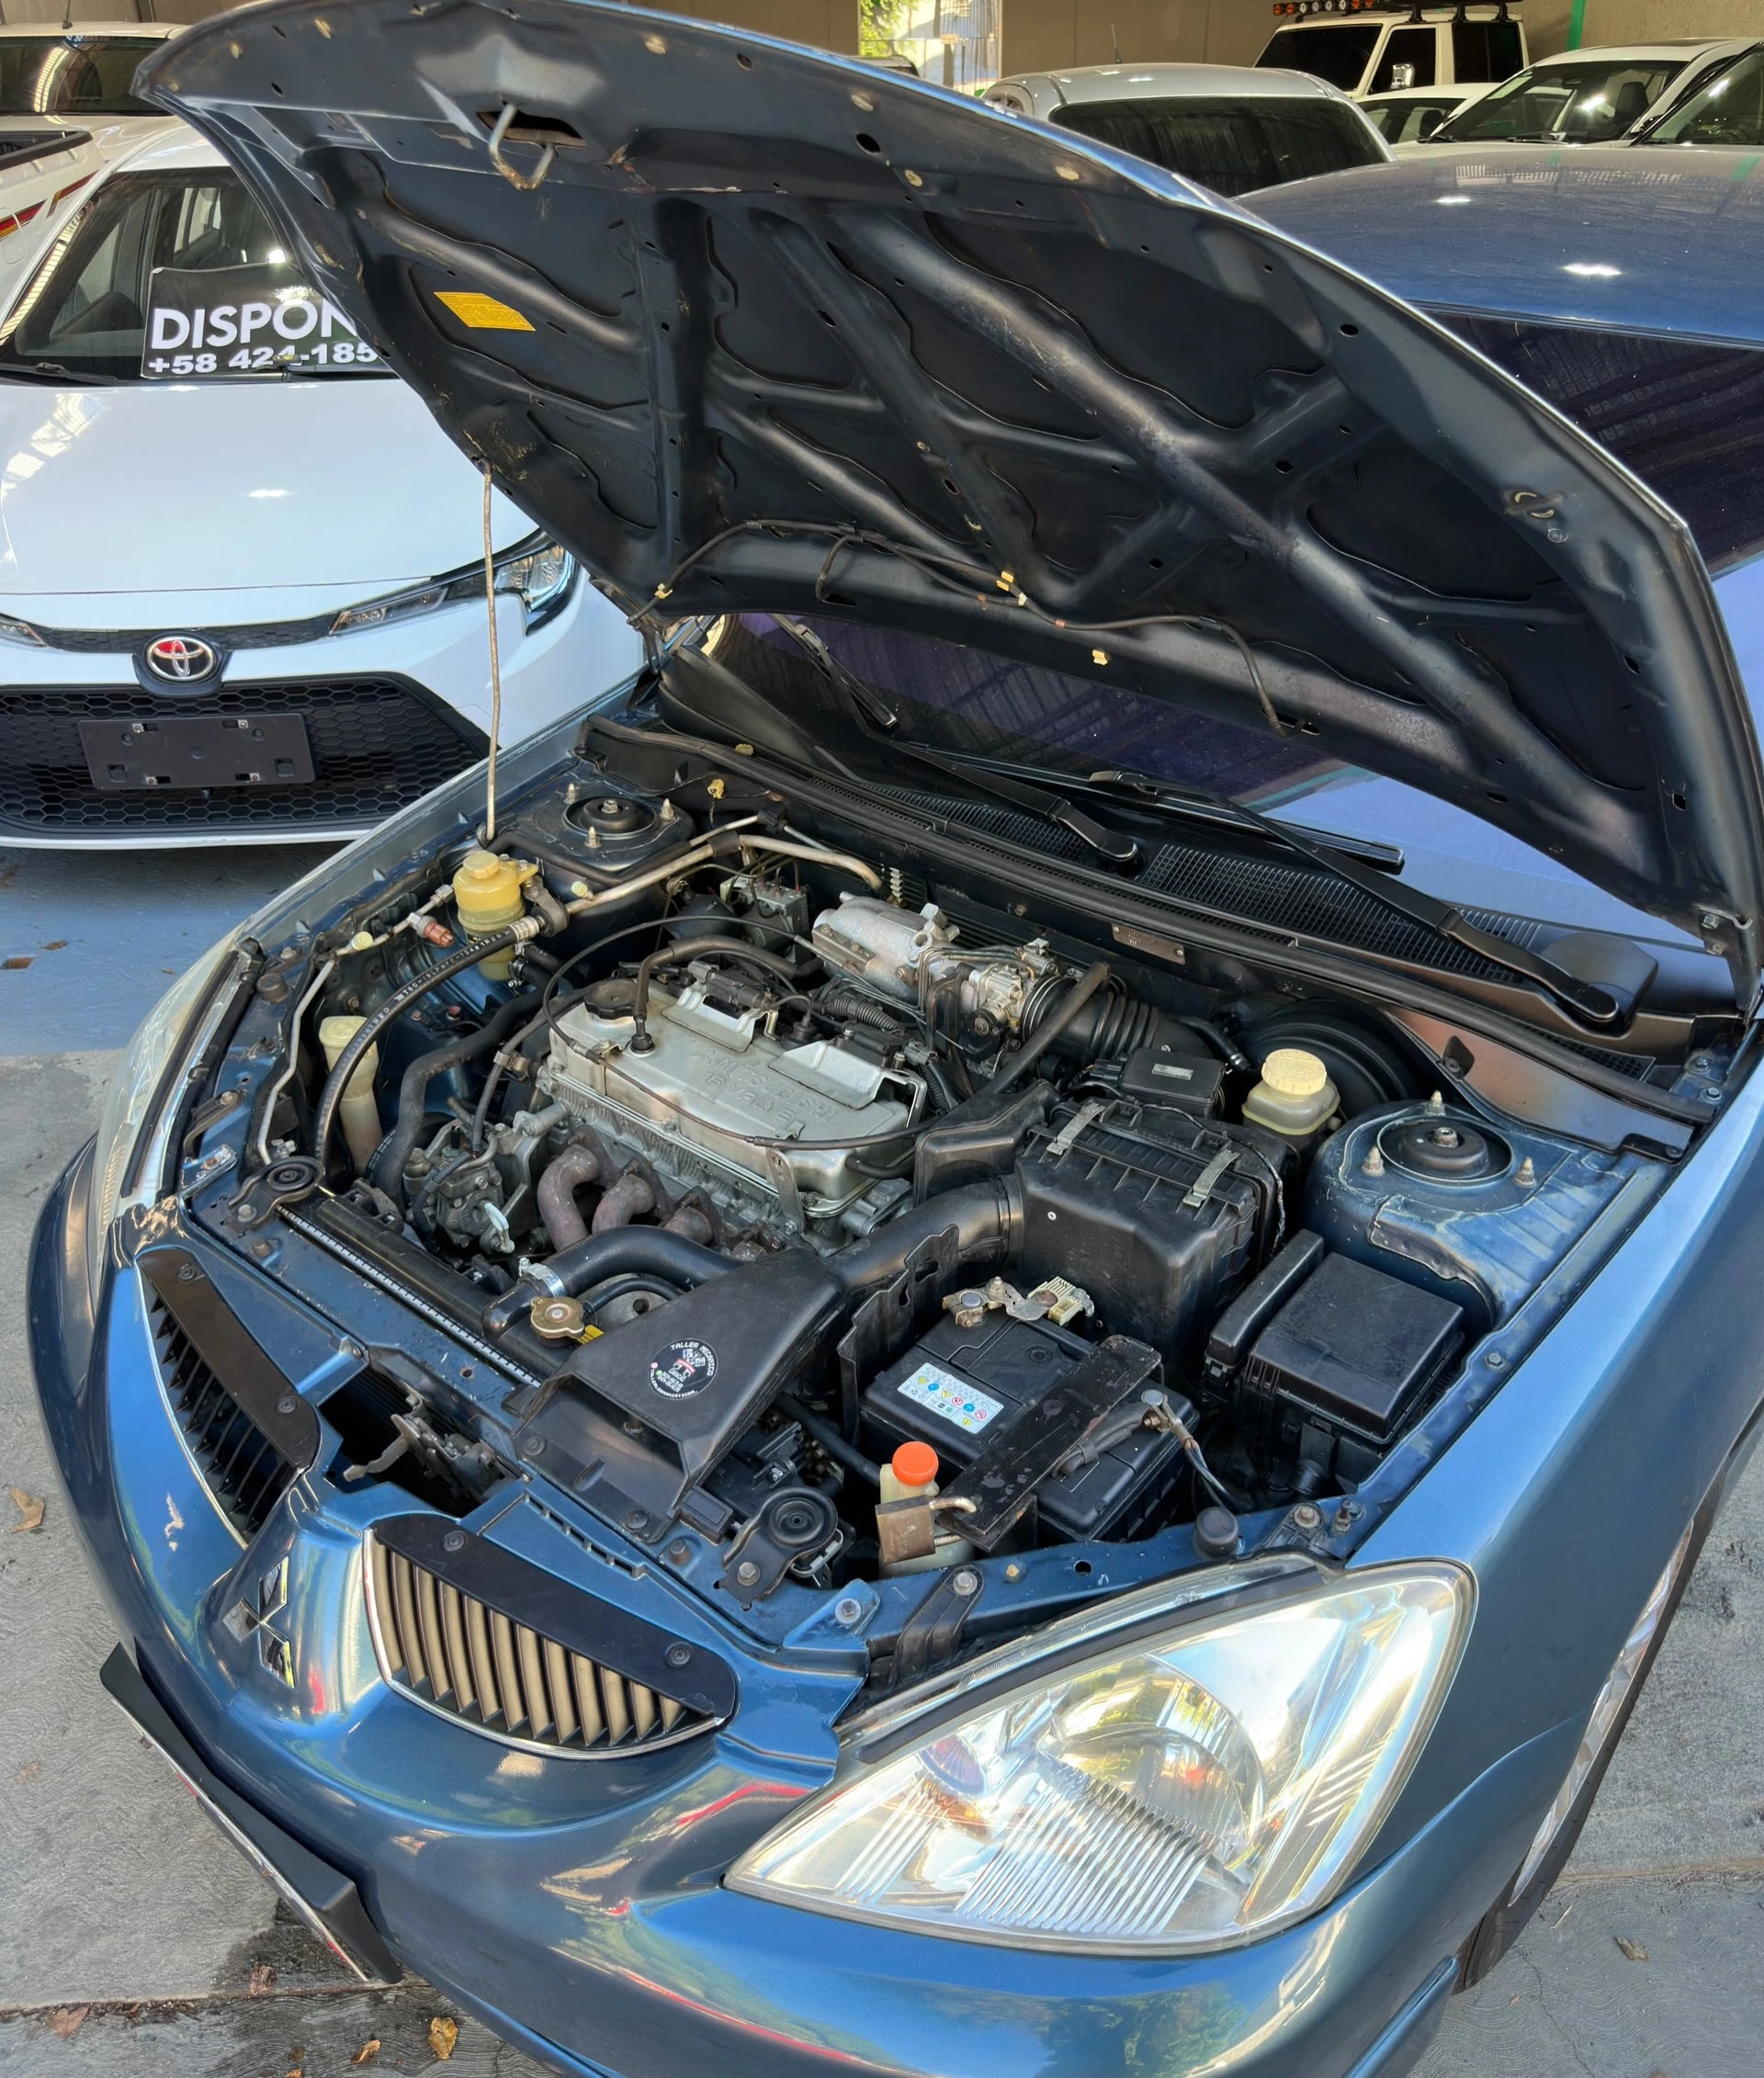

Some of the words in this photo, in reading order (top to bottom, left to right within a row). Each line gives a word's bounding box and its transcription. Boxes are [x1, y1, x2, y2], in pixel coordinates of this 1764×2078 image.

[149, 353, 218, 375] +58
[700, 1071, 727, 1087] 16
[714, 1056, 839, 1122] MITSUBISHI
[671, 1341, 699, 1350] TALLER
